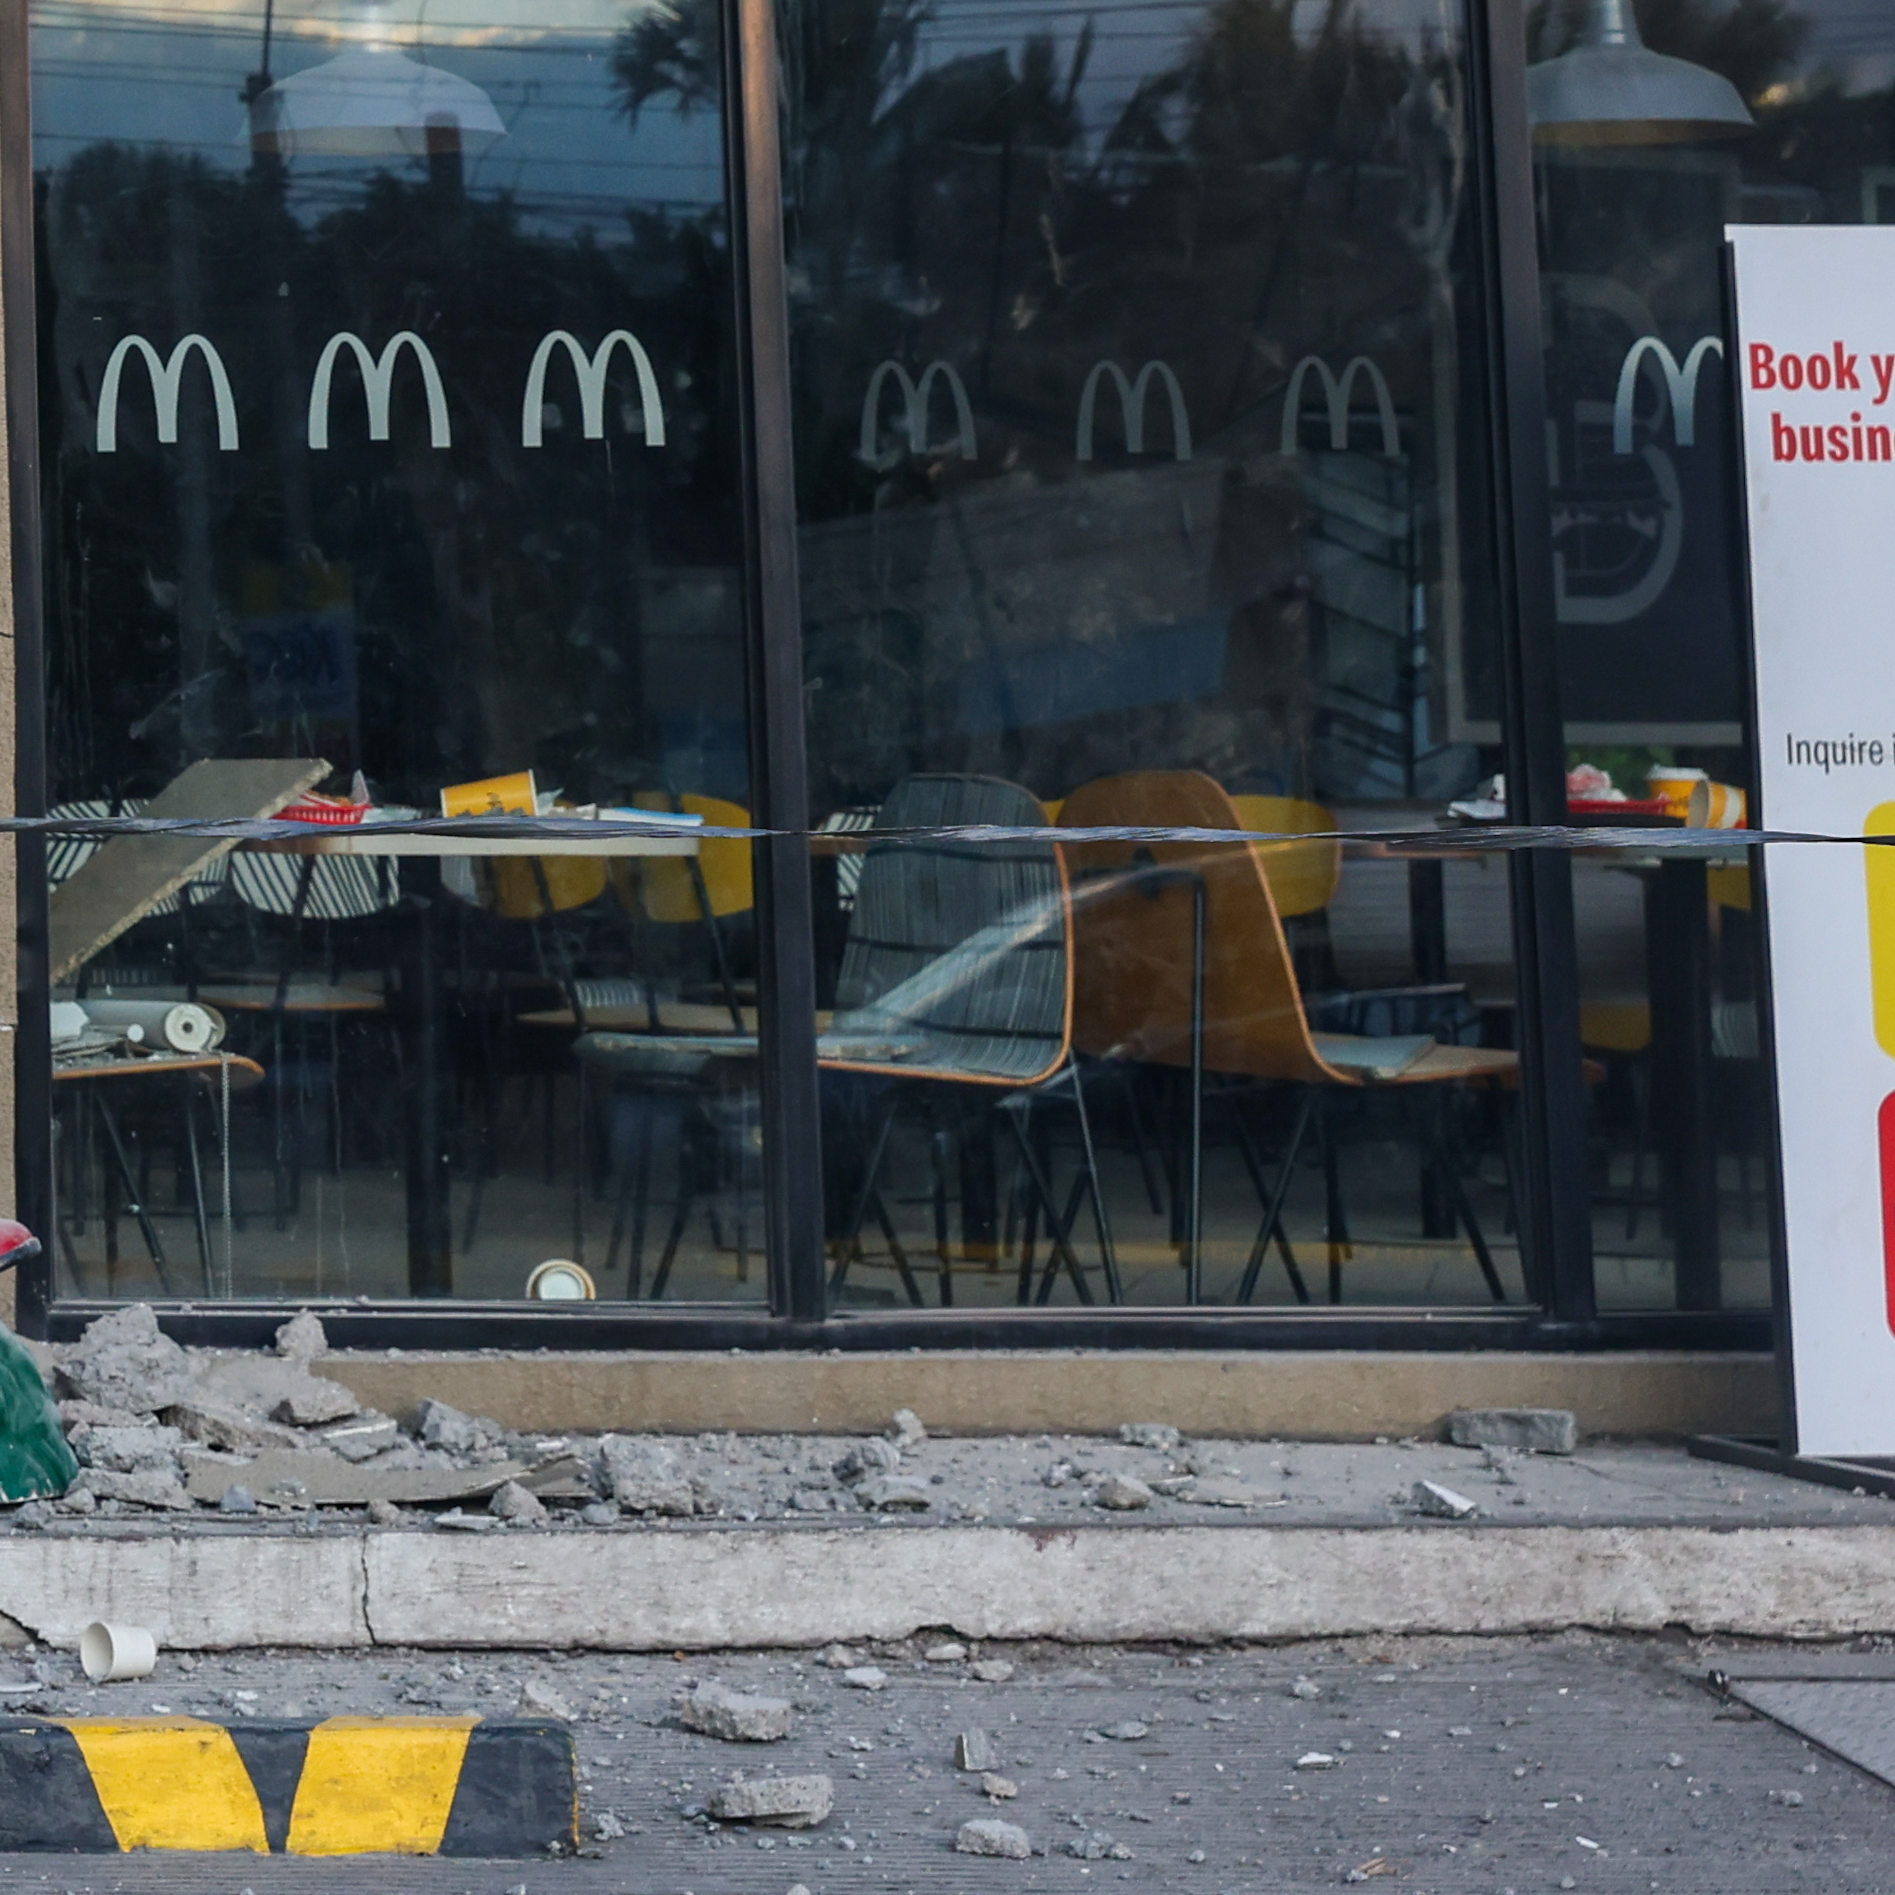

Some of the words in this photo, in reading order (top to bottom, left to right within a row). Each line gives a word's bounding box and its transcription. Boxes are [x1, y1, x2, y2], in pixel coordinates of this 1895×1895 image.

[1748, 340, 1861, 391] Book
[1771, 410, 1895, 463] busin
[1786, 732, 1884, 775] Inquire
